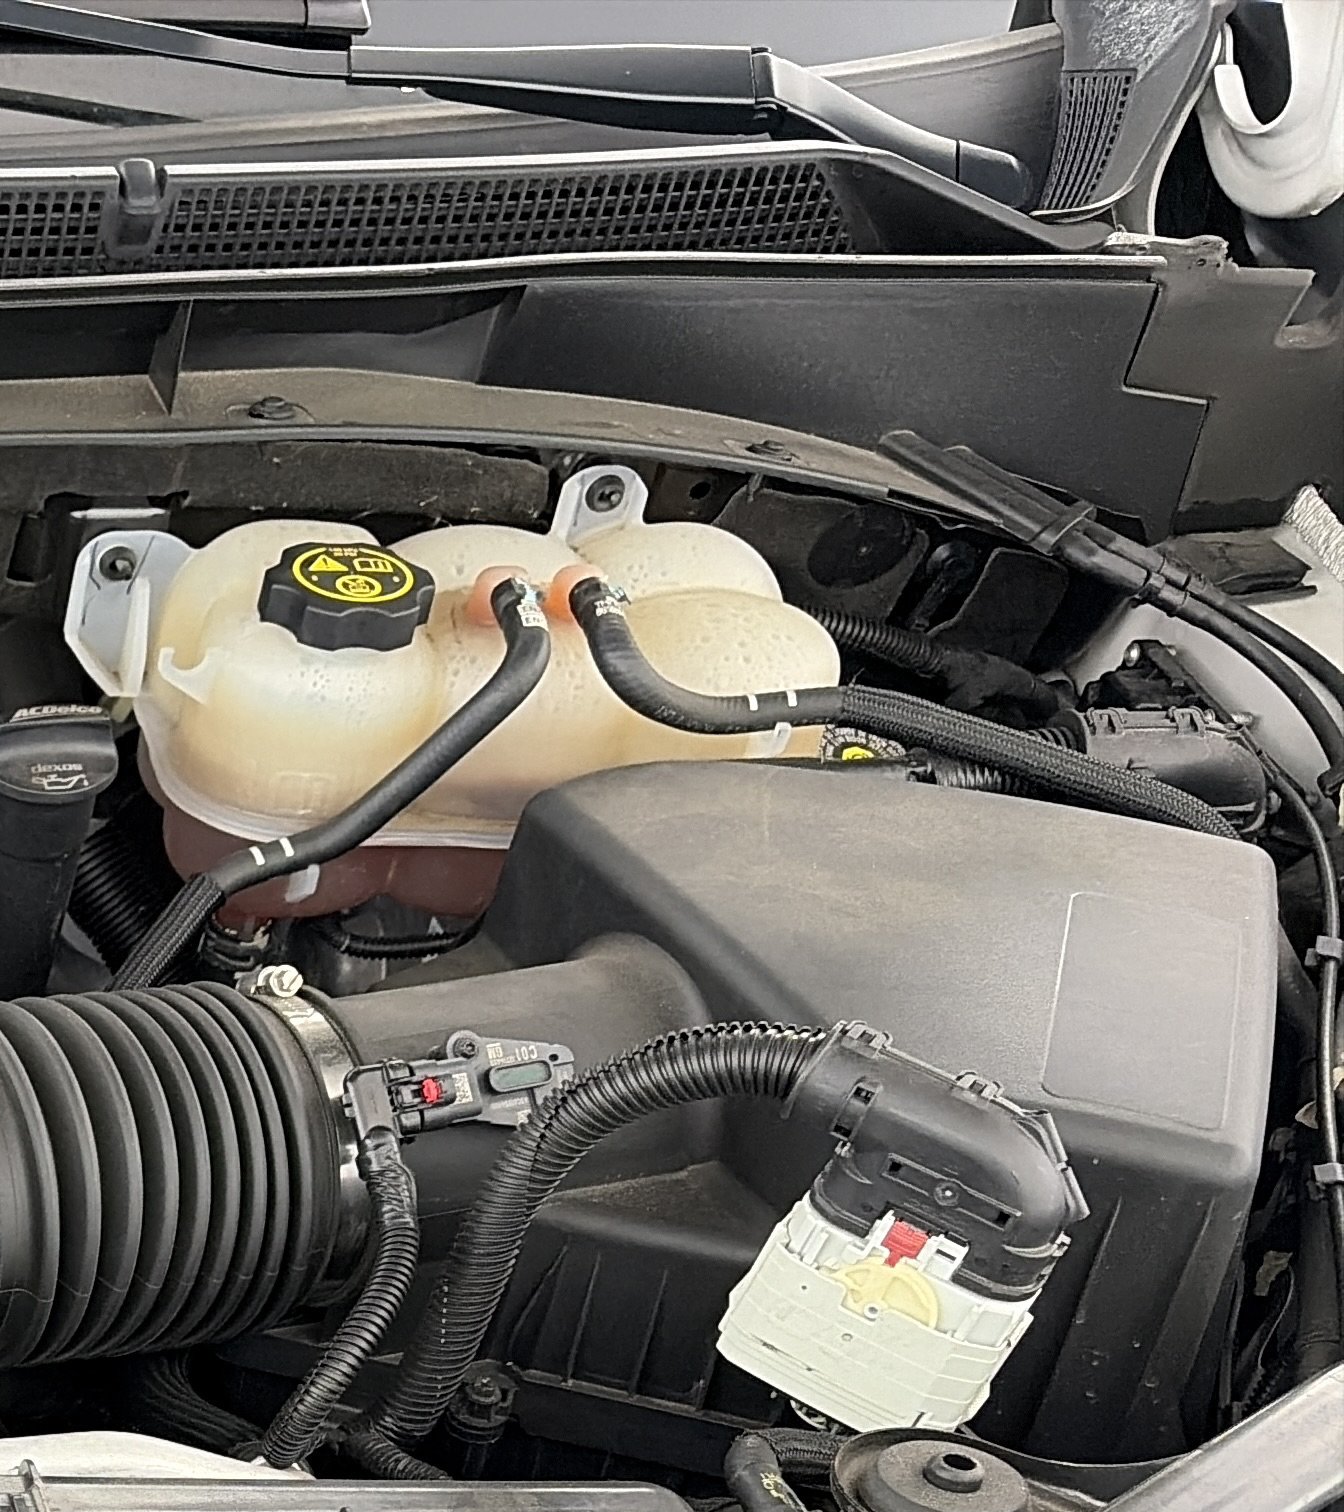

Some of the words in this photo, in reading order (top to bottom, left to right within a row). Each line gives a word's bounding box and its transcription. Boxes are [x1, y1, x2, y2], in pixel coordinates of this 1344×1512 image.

[13, 705, 103, 719] ACDelco
[31, 764, 83, 773] dexos
[487, 1045, 503, 1059] GM
